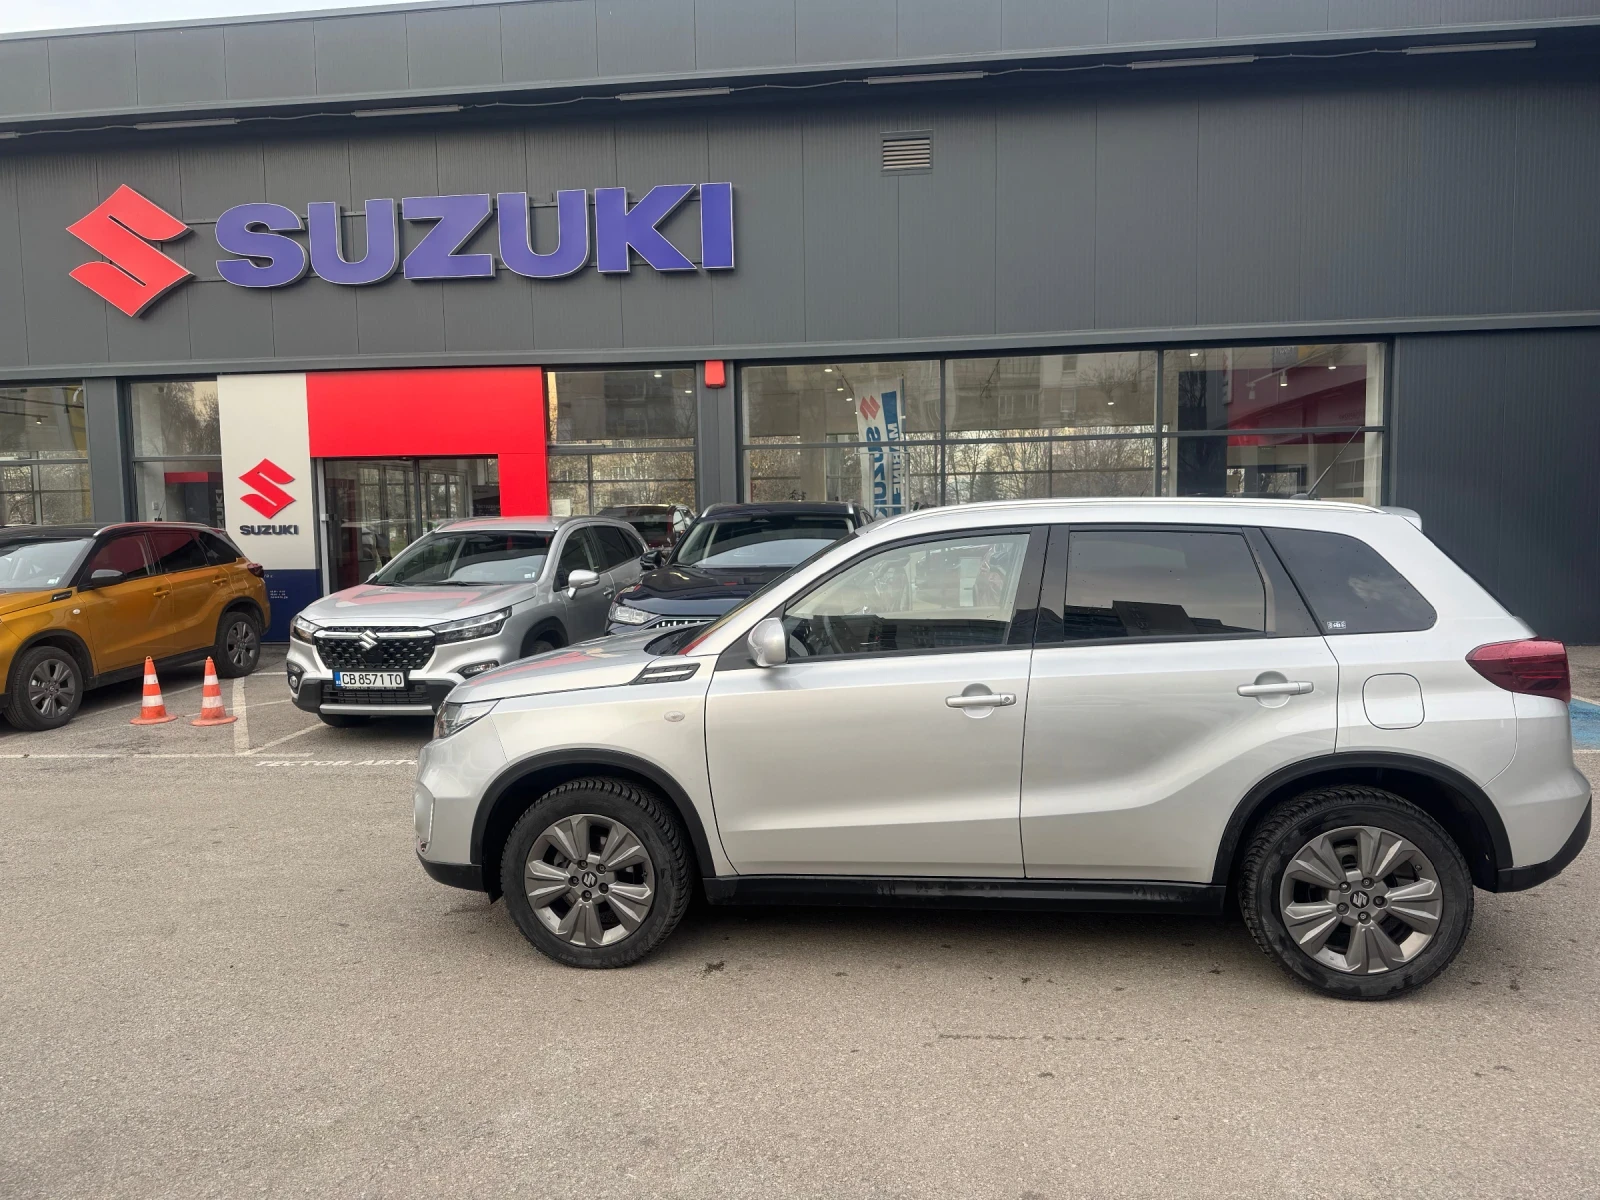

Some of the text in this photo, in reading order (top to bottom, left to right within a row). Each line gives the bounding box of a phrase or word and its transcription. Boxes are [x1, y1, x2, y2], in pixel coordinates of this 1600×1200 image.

[214, 182, 736, 288] SUZUKI
[239, 525, 298, 535] SUZUKI
[342, 674, 357, 685] CB
[358, 674, 385, 685] 8571
[387, 674, 402, 685] TO
